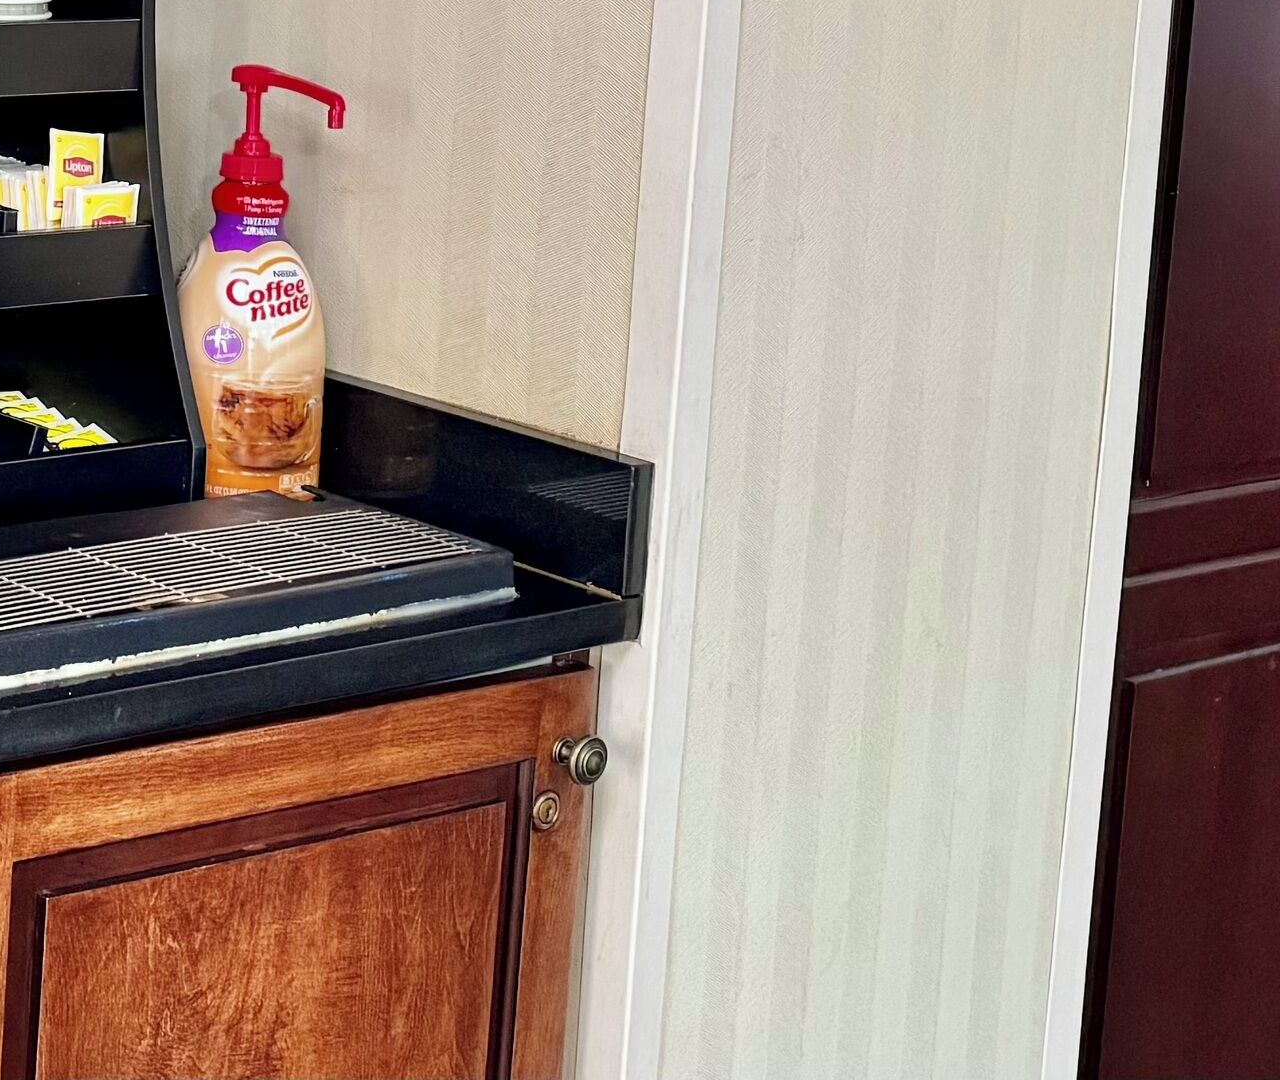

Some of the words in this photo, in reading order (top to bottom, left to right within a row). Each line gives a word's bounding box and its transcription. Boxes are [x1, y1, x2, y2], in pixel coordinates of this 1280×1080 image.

[65, 160, 92, 173] Lipton
[226, 278, 305, 307] Coffee
[250, 293, 310, 322] mate
